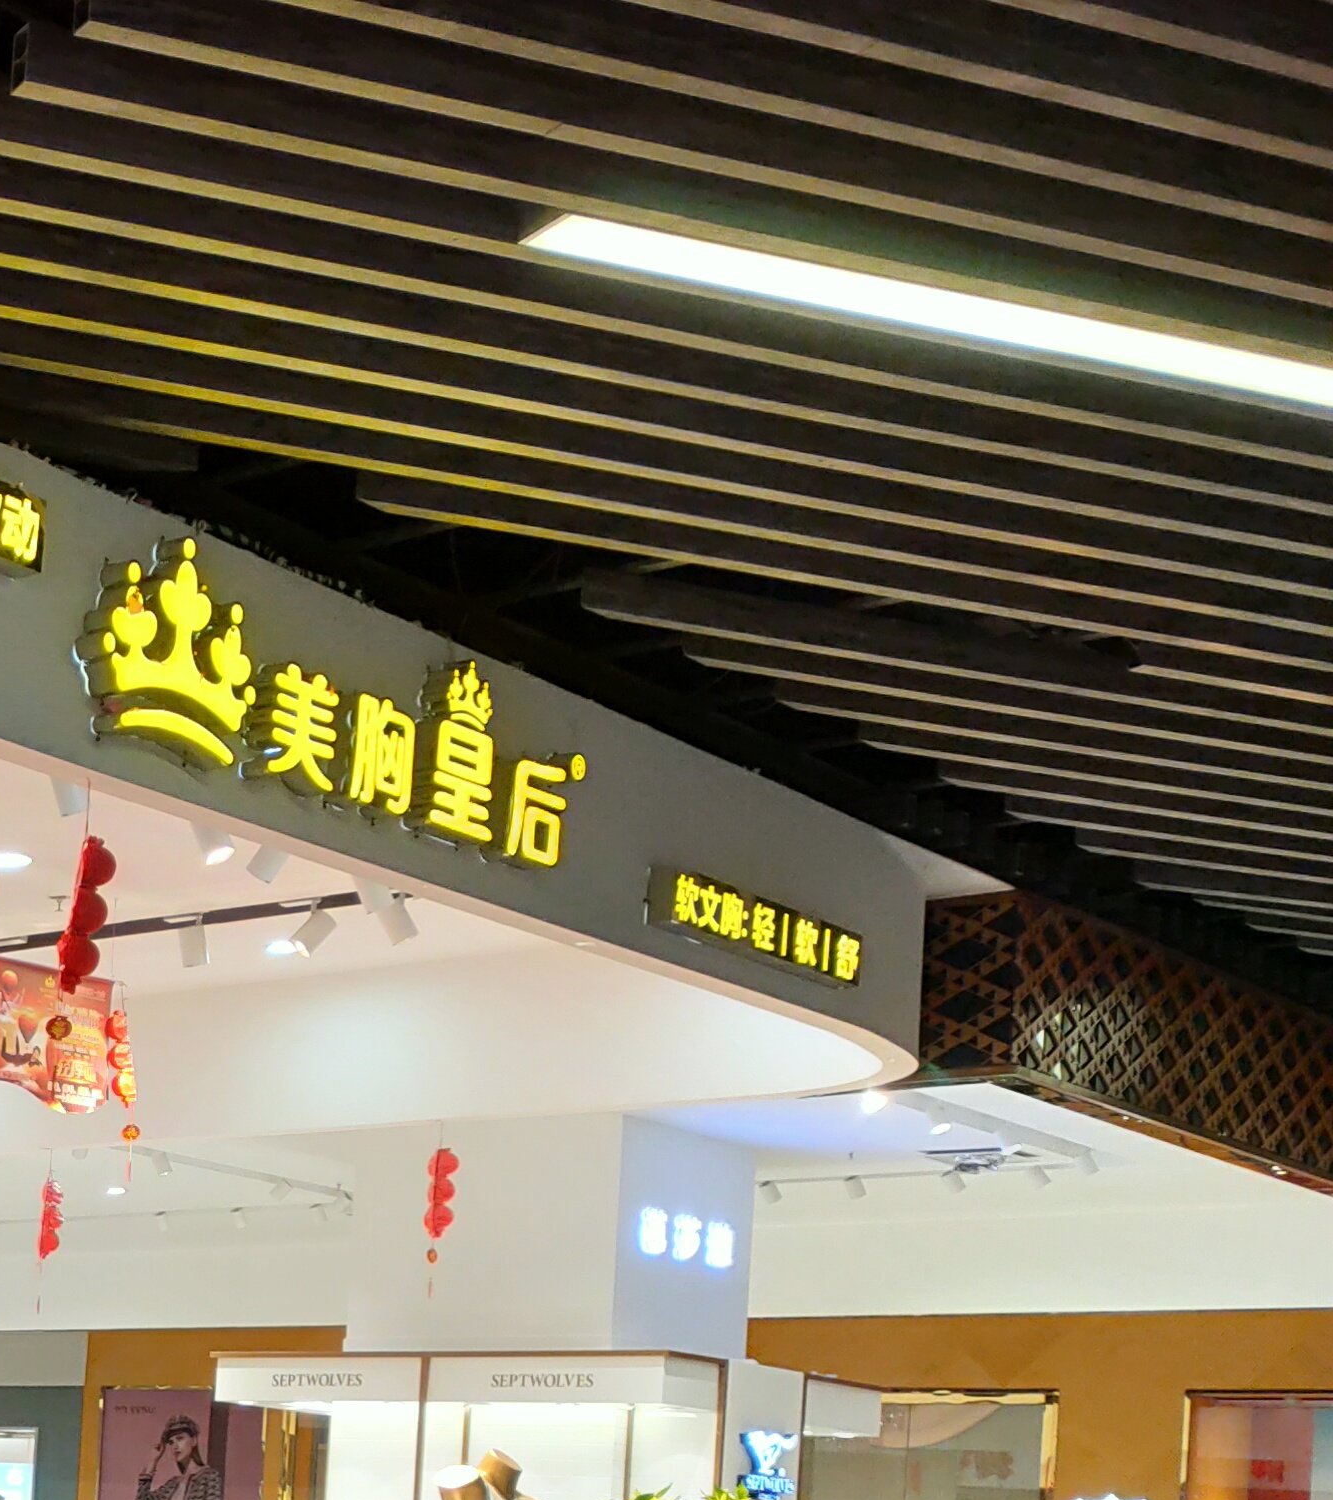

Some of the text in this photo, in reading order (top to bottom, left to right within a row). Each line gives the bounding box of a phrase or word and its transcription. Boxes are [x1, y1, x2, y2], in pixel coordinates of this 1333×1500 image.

[268, 661, 568, 868] 美胸皇后
[271, 1373, 363, 1388] SEPTWOLVES
[490, 1373, 594, 1389] SEPTWOLVES
